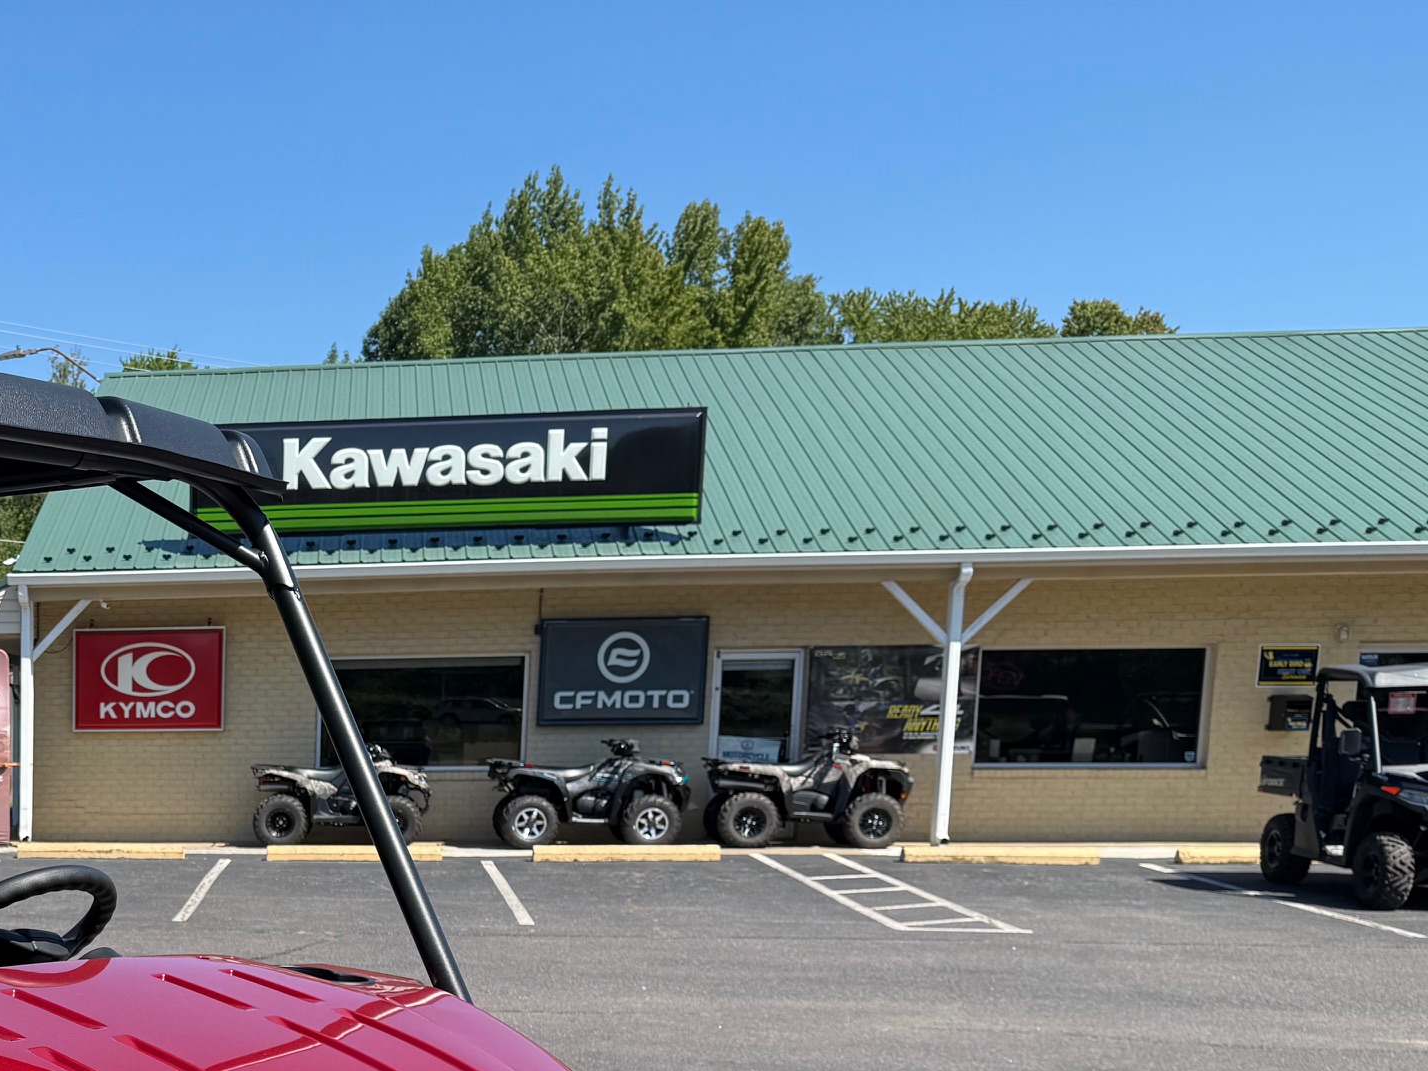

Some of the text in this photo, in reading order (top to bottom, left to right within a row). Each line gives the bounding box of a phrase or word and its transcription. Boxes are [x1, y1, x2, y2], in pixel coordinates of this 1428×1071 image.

[282, 427, 609, 490] Kawasaki
[99, 700, 196, 719] KYMCO
[553, 689, 690, 710] CFMOTO
